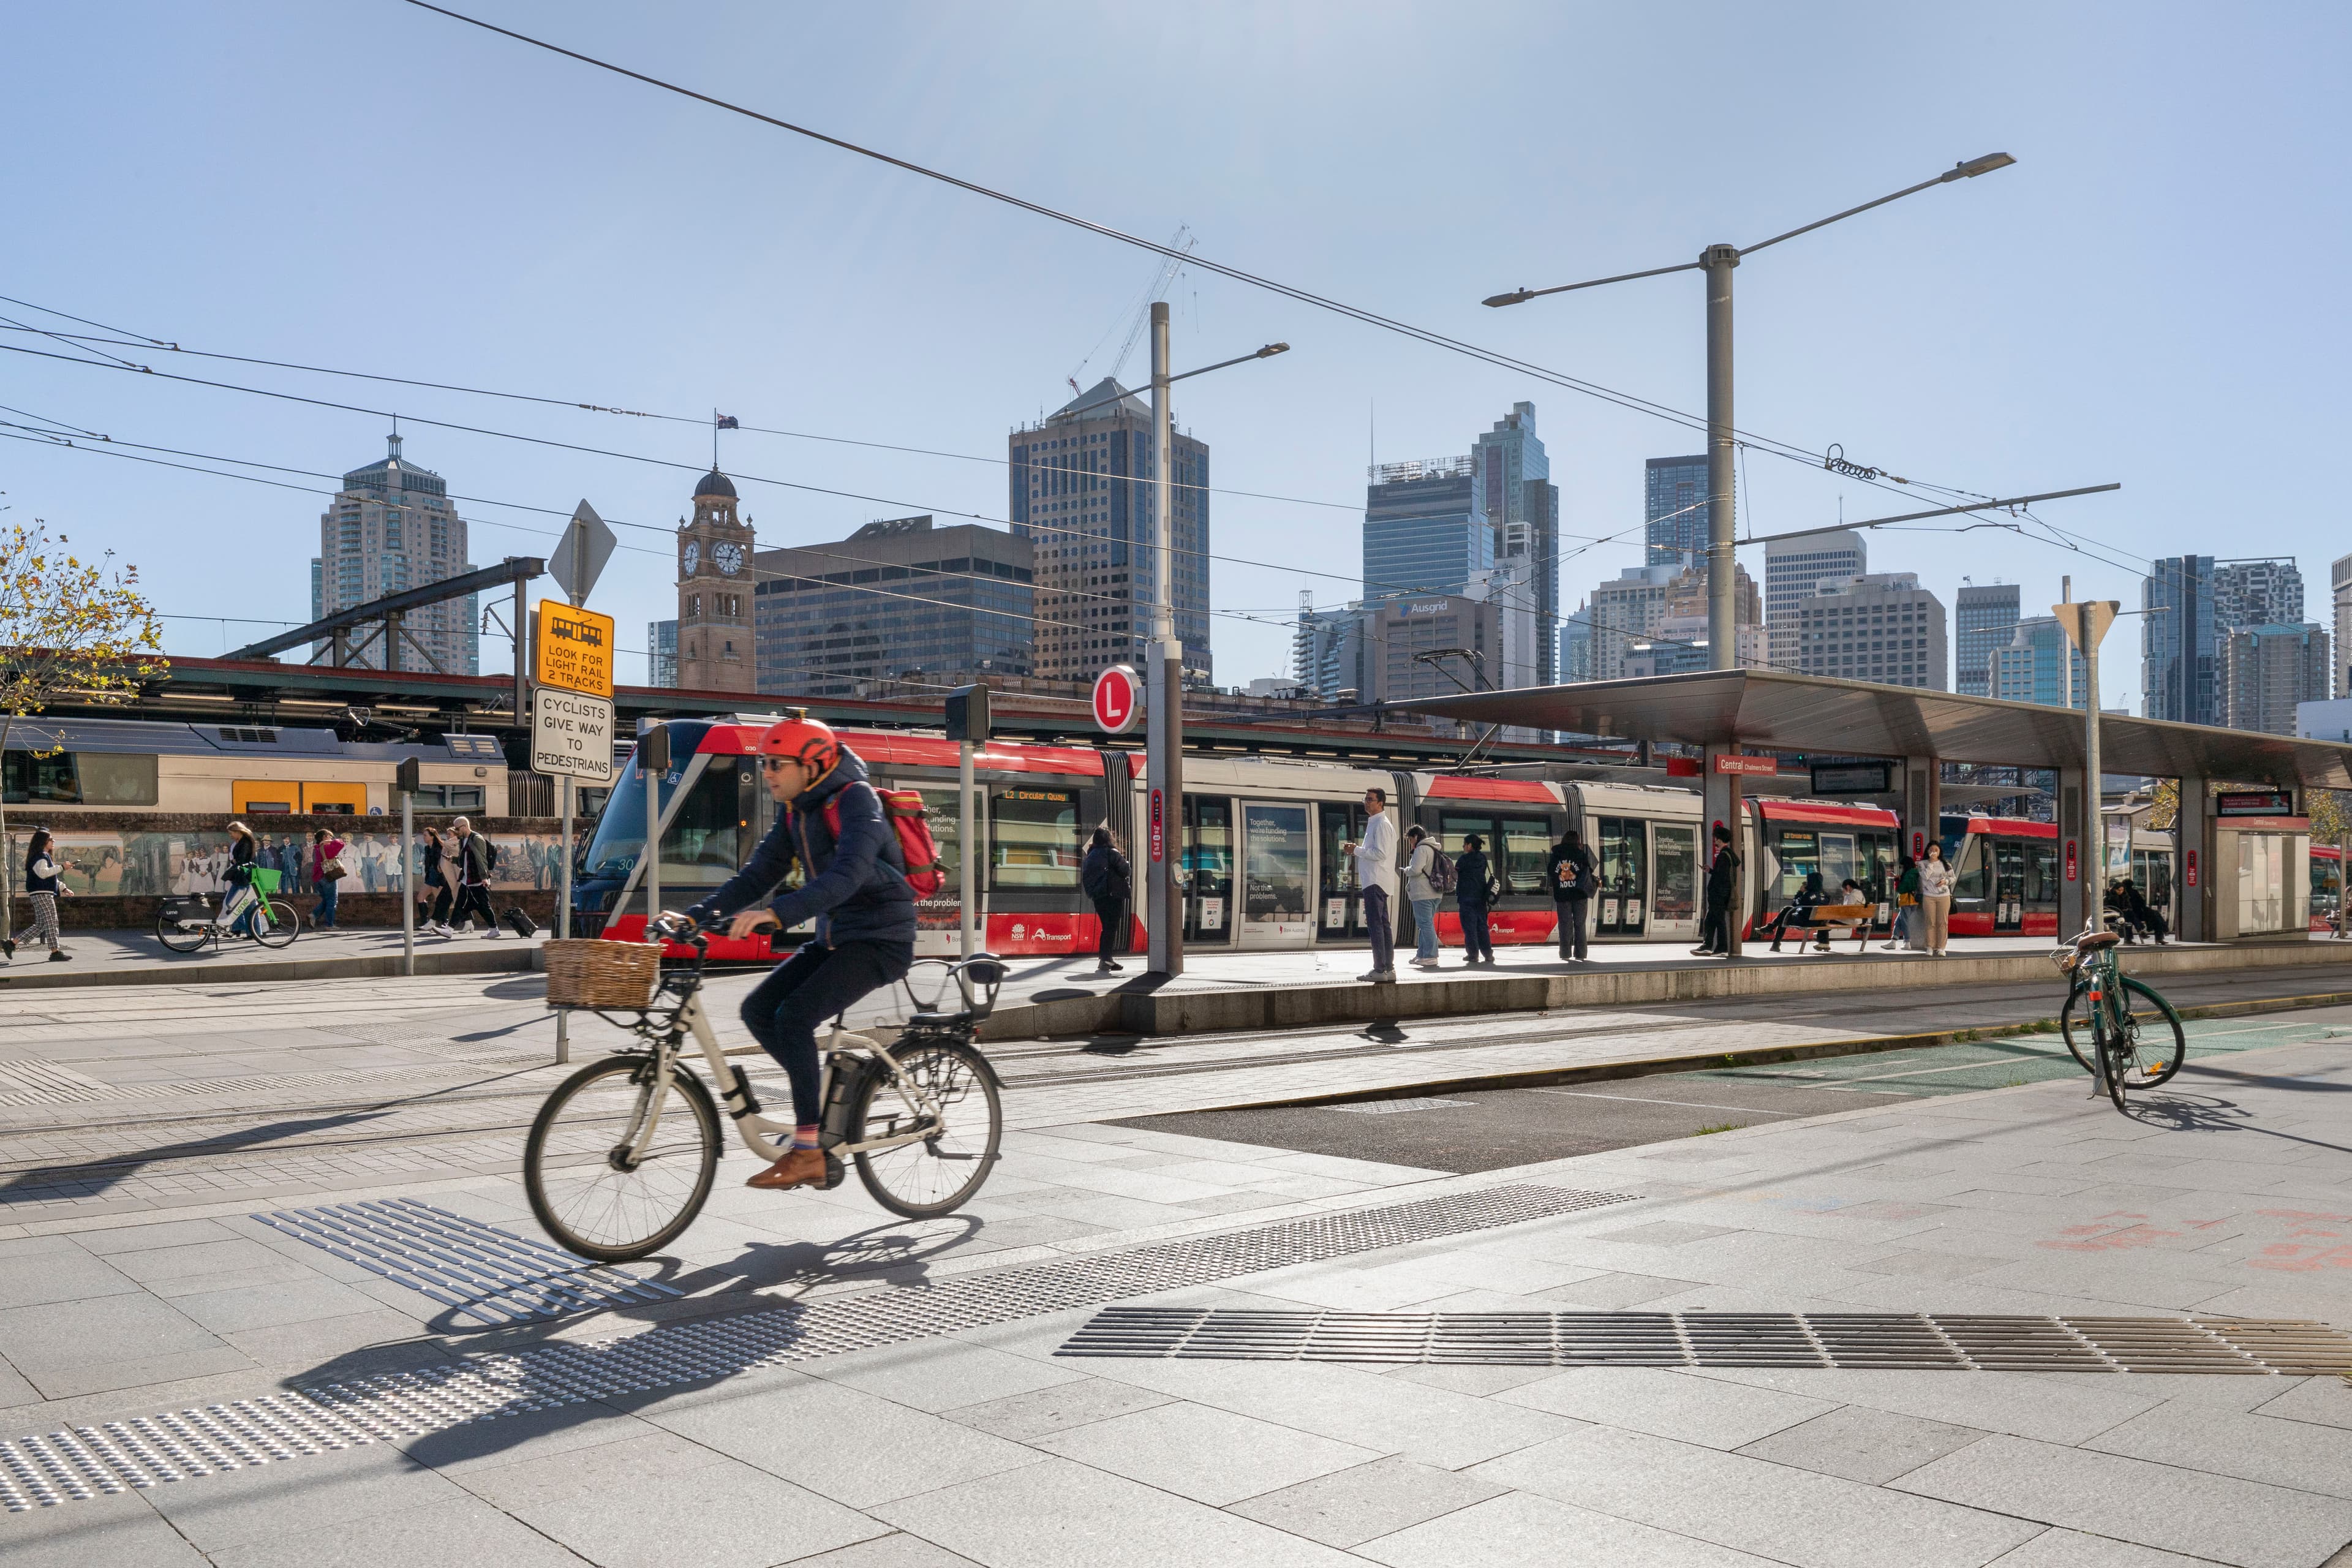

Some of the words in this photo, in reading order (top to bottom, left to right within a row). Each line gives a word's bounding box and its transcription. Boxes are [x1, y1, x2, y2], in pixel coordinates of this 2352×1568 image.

[1411, 600, 1447, 614] Ausgrid
[549, 646, 578, 660] LOOK
[582, 654, 603, 666] FOR
[546, 657, 576, 672] LIGHT
[581, 665, 605, 679] RAIL
[549, 670, 555, 679] 2
[560, 673, 603, 690] TRACKS
[544, 698, 605, 719] CYCLISTS
[1106, 682, 1121, 717] L
[545, 716, 573, 731] GIVE
[579, 722, 603, 736] WAY
[567, 738, 582, 750] TO
[537, 752, 608, 774] PEDESTRIANS
[1721, 760, 1743, 770] Central
[1005, 790, 1014, 799] L2
[1019, 791, 1045, 800] Circular
[1047, 793, 1066, 802] Quay
[1265, 827, 1287, 835] funding
[1250, 892, 1278, 901] problems.
